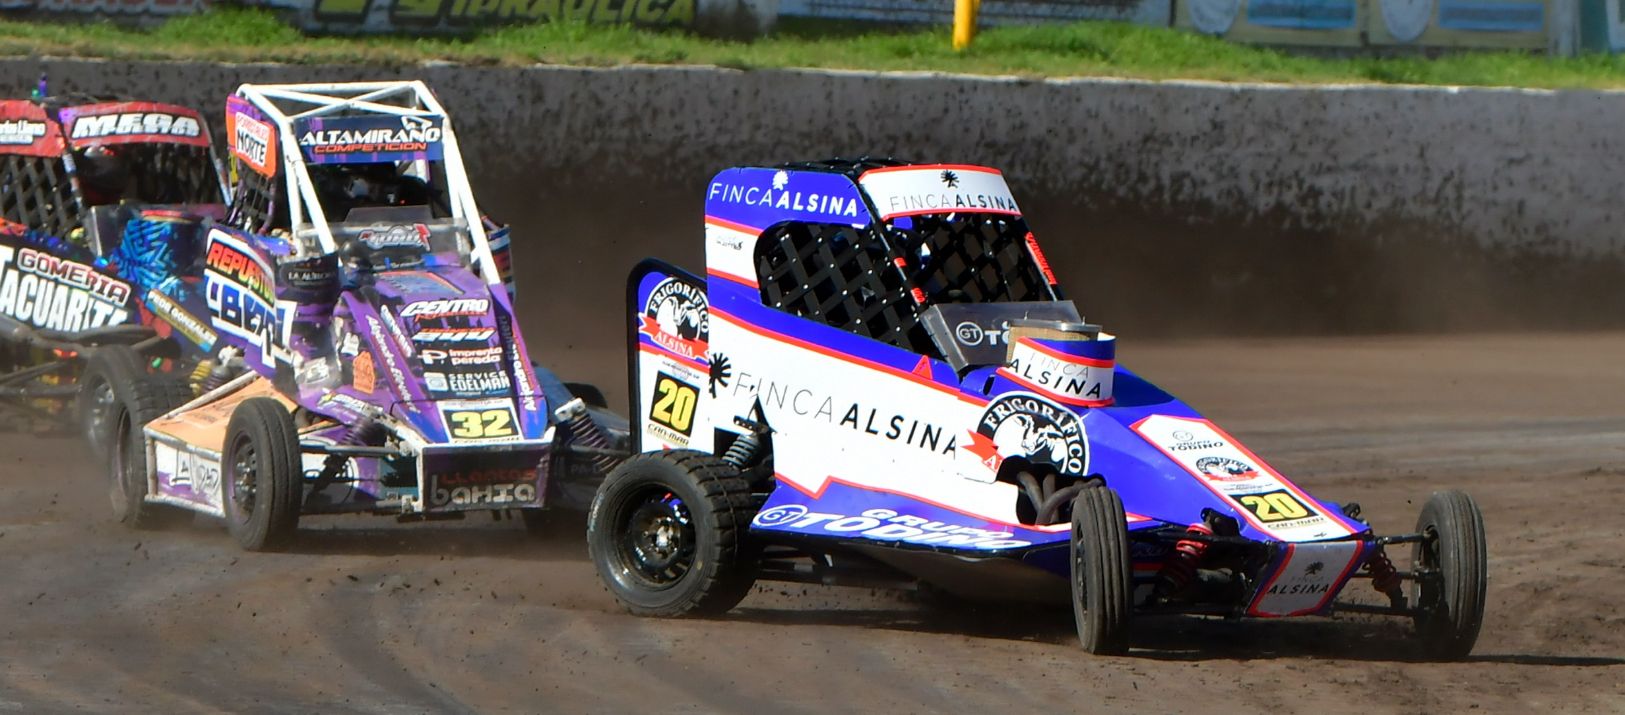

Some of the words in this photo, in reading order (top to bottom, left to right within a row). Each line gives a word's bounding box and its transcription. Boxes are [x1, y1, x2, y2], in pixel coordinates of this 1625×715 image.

[72, 113, 200, 138] MEGA
[300, 127, 441, 146] ALTAMIRANO
[236, 128, 267, 165] NORTE
[313, 143, 427, 154] COMPETICION
[709, 182, 772, 207] FINCA
[776, 190, 858, 217] ALSINA
[955, 194, 1018, 212] ALSINA
[17, 247, 131, 307] GOMERIA
[400, 299, 488, 317] CENTRO
[653, 332, 694, 358] ALSINA
[959, 328, 978, 340] GT
[449, 346, 502, 357] imprenta
[452, 354, 500, 366] pereda
[448, 370, 507, 381] SERVICE
[451, 376, 511, 392] EDELMAN
[1009, 358, 1102, 399] ALSINA
[652, 378, 696, 432] 20
[451, 409, 512, 438] 32
[1241, 493, 1308, 521] 20
[790, 512, 1033, 550] TODINO
[861, 508, 1015, 539] GRUPO
[1267, 583, 1331, 595] ALSINA
